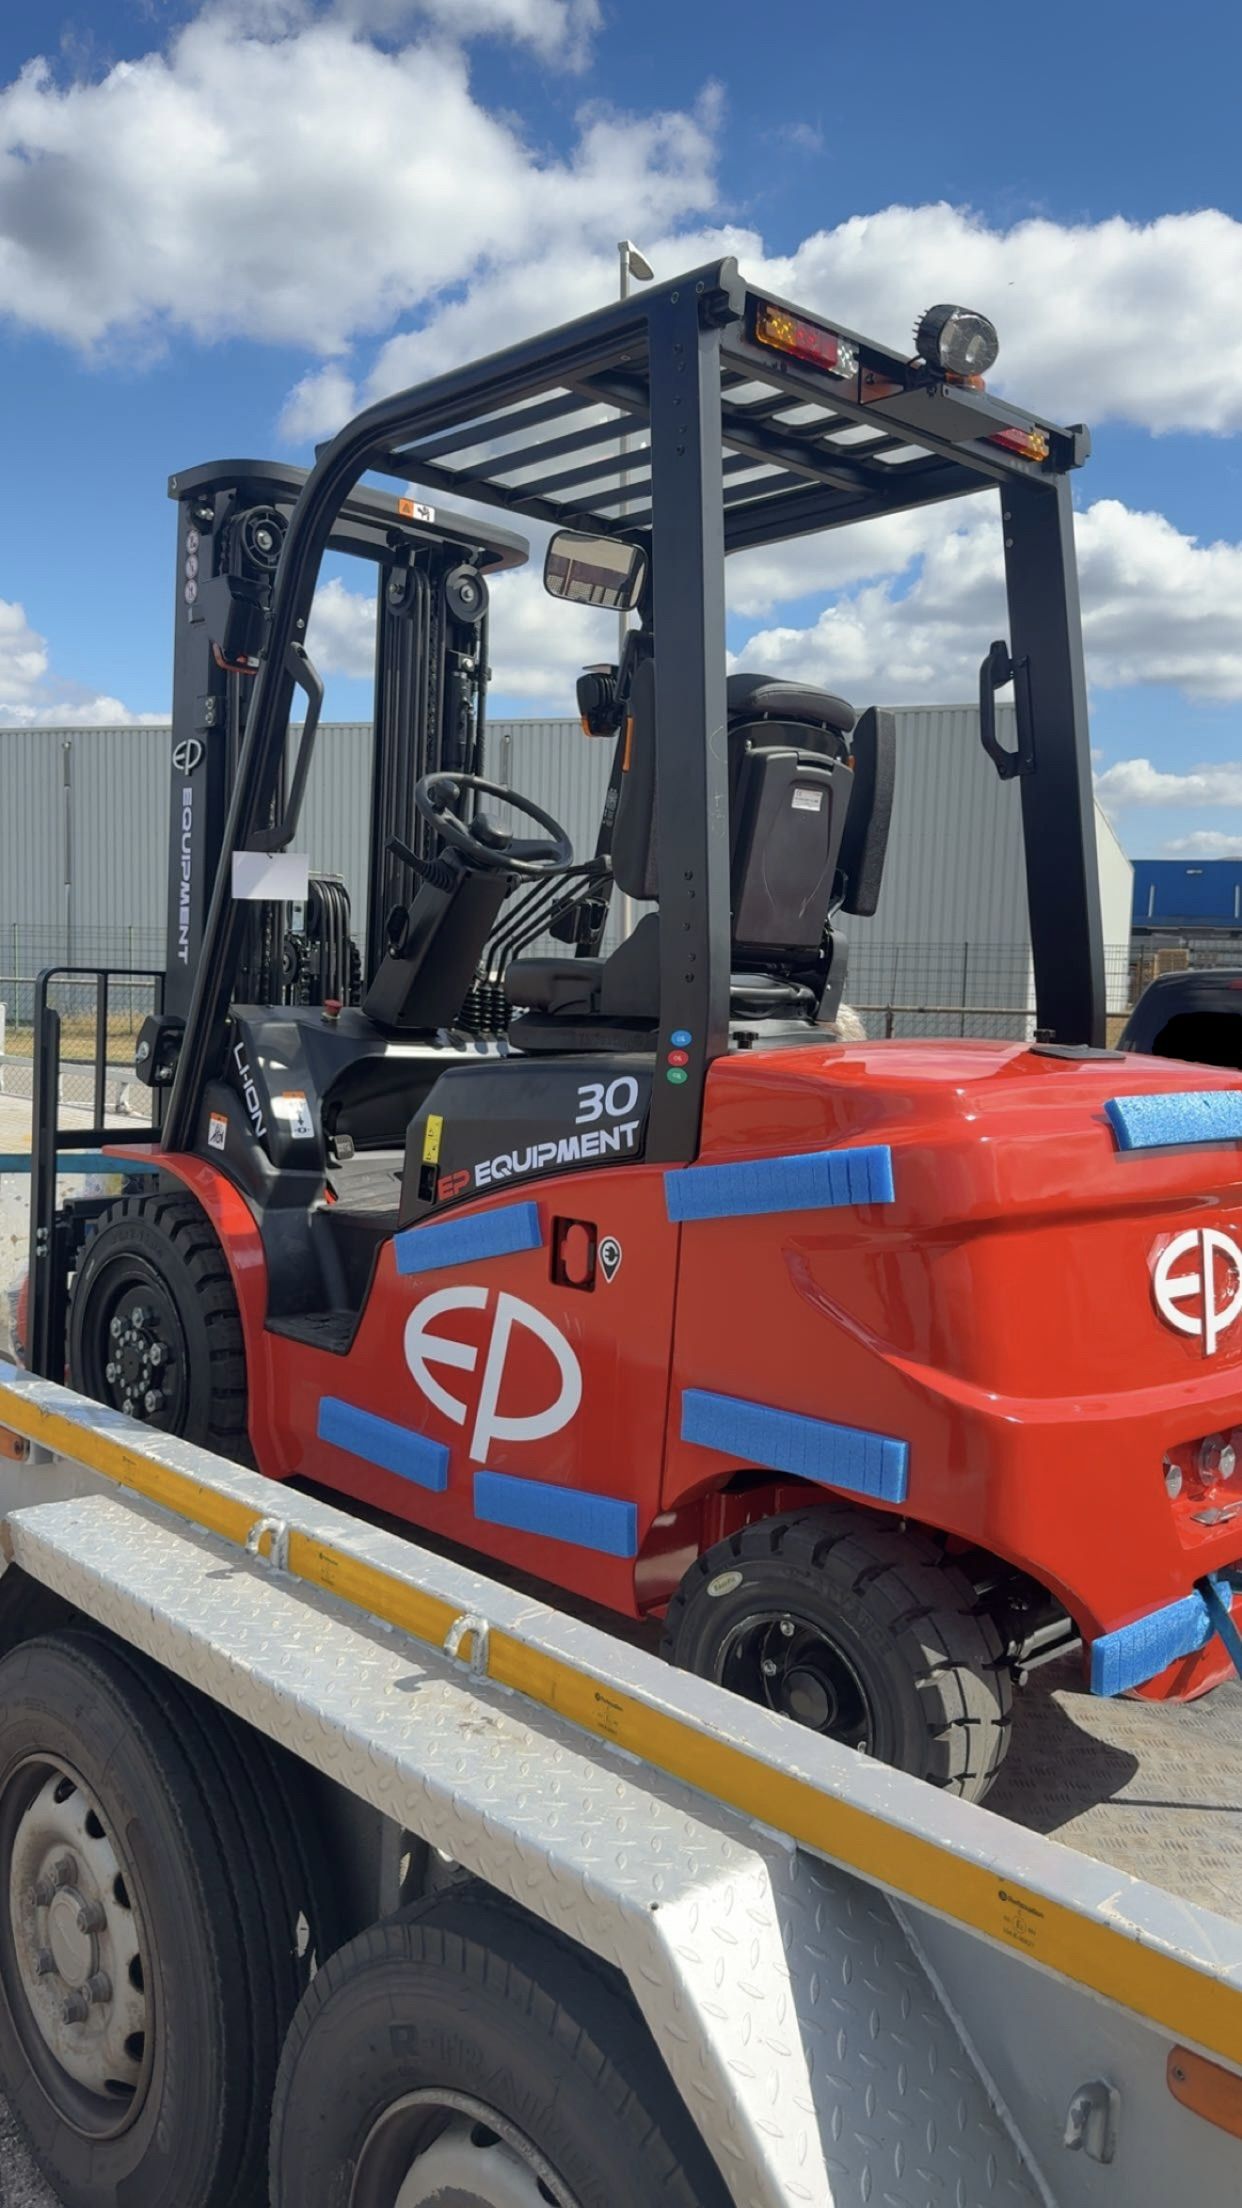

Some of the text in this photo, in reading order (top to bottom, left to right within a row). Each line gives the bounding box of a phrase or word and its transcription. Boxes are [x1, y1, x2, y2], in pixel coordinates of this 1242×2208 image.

[177, 787, 193, 965] EQUIPMENT
[234, 1042, 267, 1137] LI-ION
[575, 1076, 639, 1124] 30
[438, 1169, 471, 1200] EP
[474, 1120, 640, 1187] EQUIPMENT
